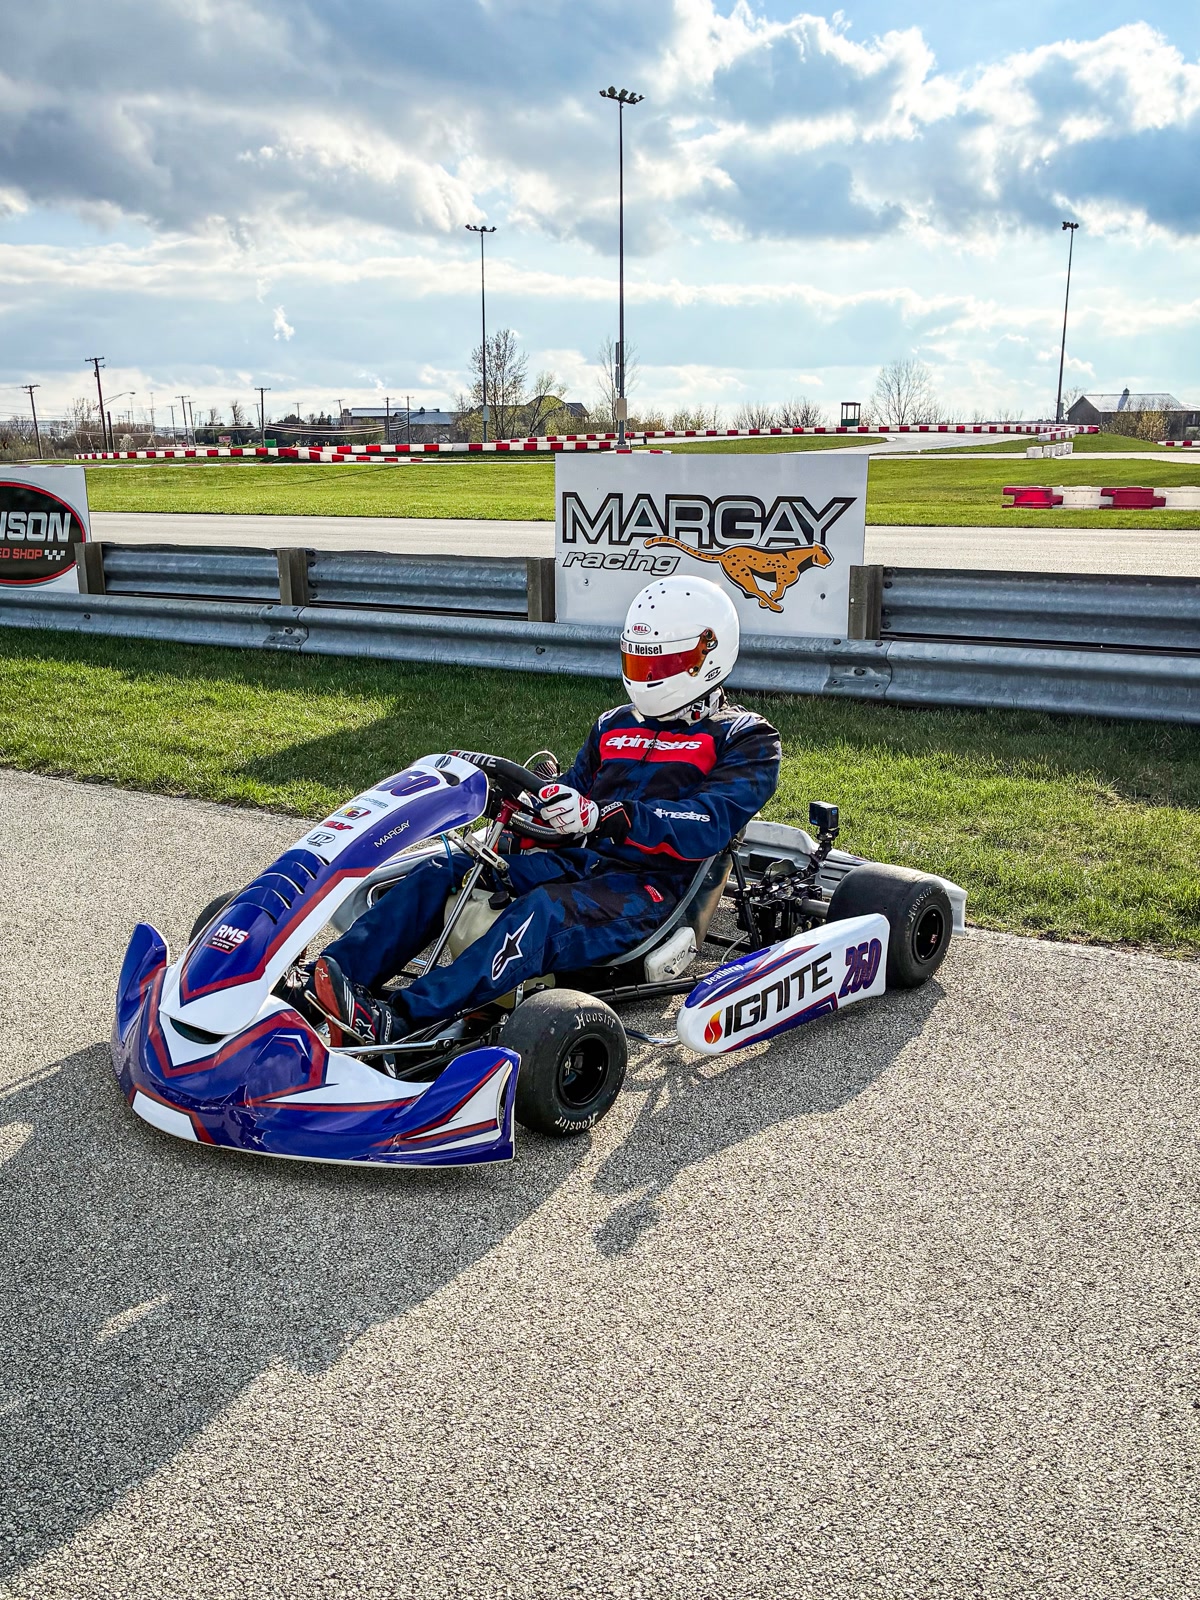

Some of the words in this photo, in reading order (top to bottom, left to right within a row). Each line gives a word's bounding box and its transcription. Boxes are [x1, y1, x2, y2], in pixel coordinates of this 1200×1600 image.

[562, 492, 857, 548] MARGAY
[12, 548, 43, 560] SHOP
[562, 550, 681, 576] racing
[373, 819, 411, 848] MARGAY
[214, 924, 249, 944] RMS
[838, 938, 882, 999] 260
[724, 952, 833, 1038] IGNITE
